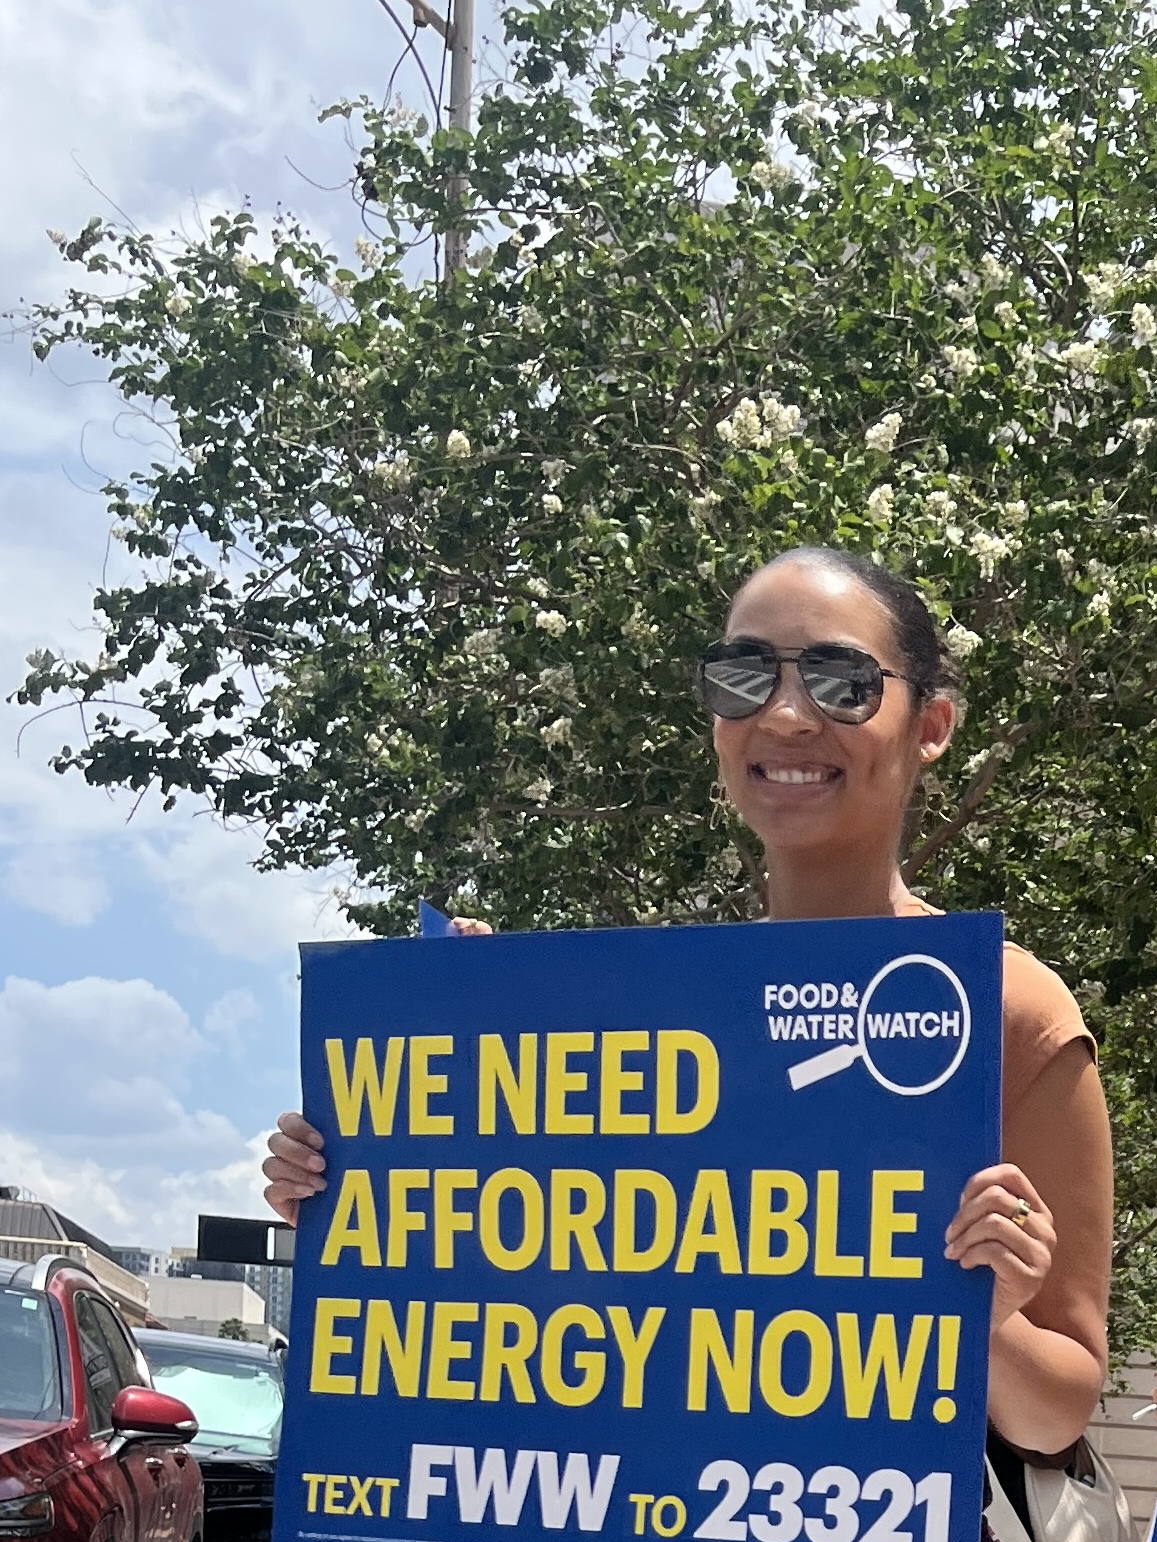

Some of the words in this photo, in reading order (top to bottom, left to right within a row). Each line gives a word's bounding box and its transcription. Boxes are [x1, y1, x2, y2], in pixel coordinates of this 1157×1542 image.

[764, 982, 859, 1010] FOOD&
[768, 1013, 856, 1041] WATER
[867, 1010, 961, 1039] WATCH
[325, 1036, 454, 1137] WE
[478, 1030, 720, 1136] NEED
[320, 1168, 924, 1279] AFFORDABLE
[309, 1298, 666, 1409] ENERGY
[687, 1308, 961, 1424] NOW!
[302, 1474, 399, 1517] TEXT
[406, 1443, 621, 1532] FWW
[629, 1492, 687, 1538] TO
